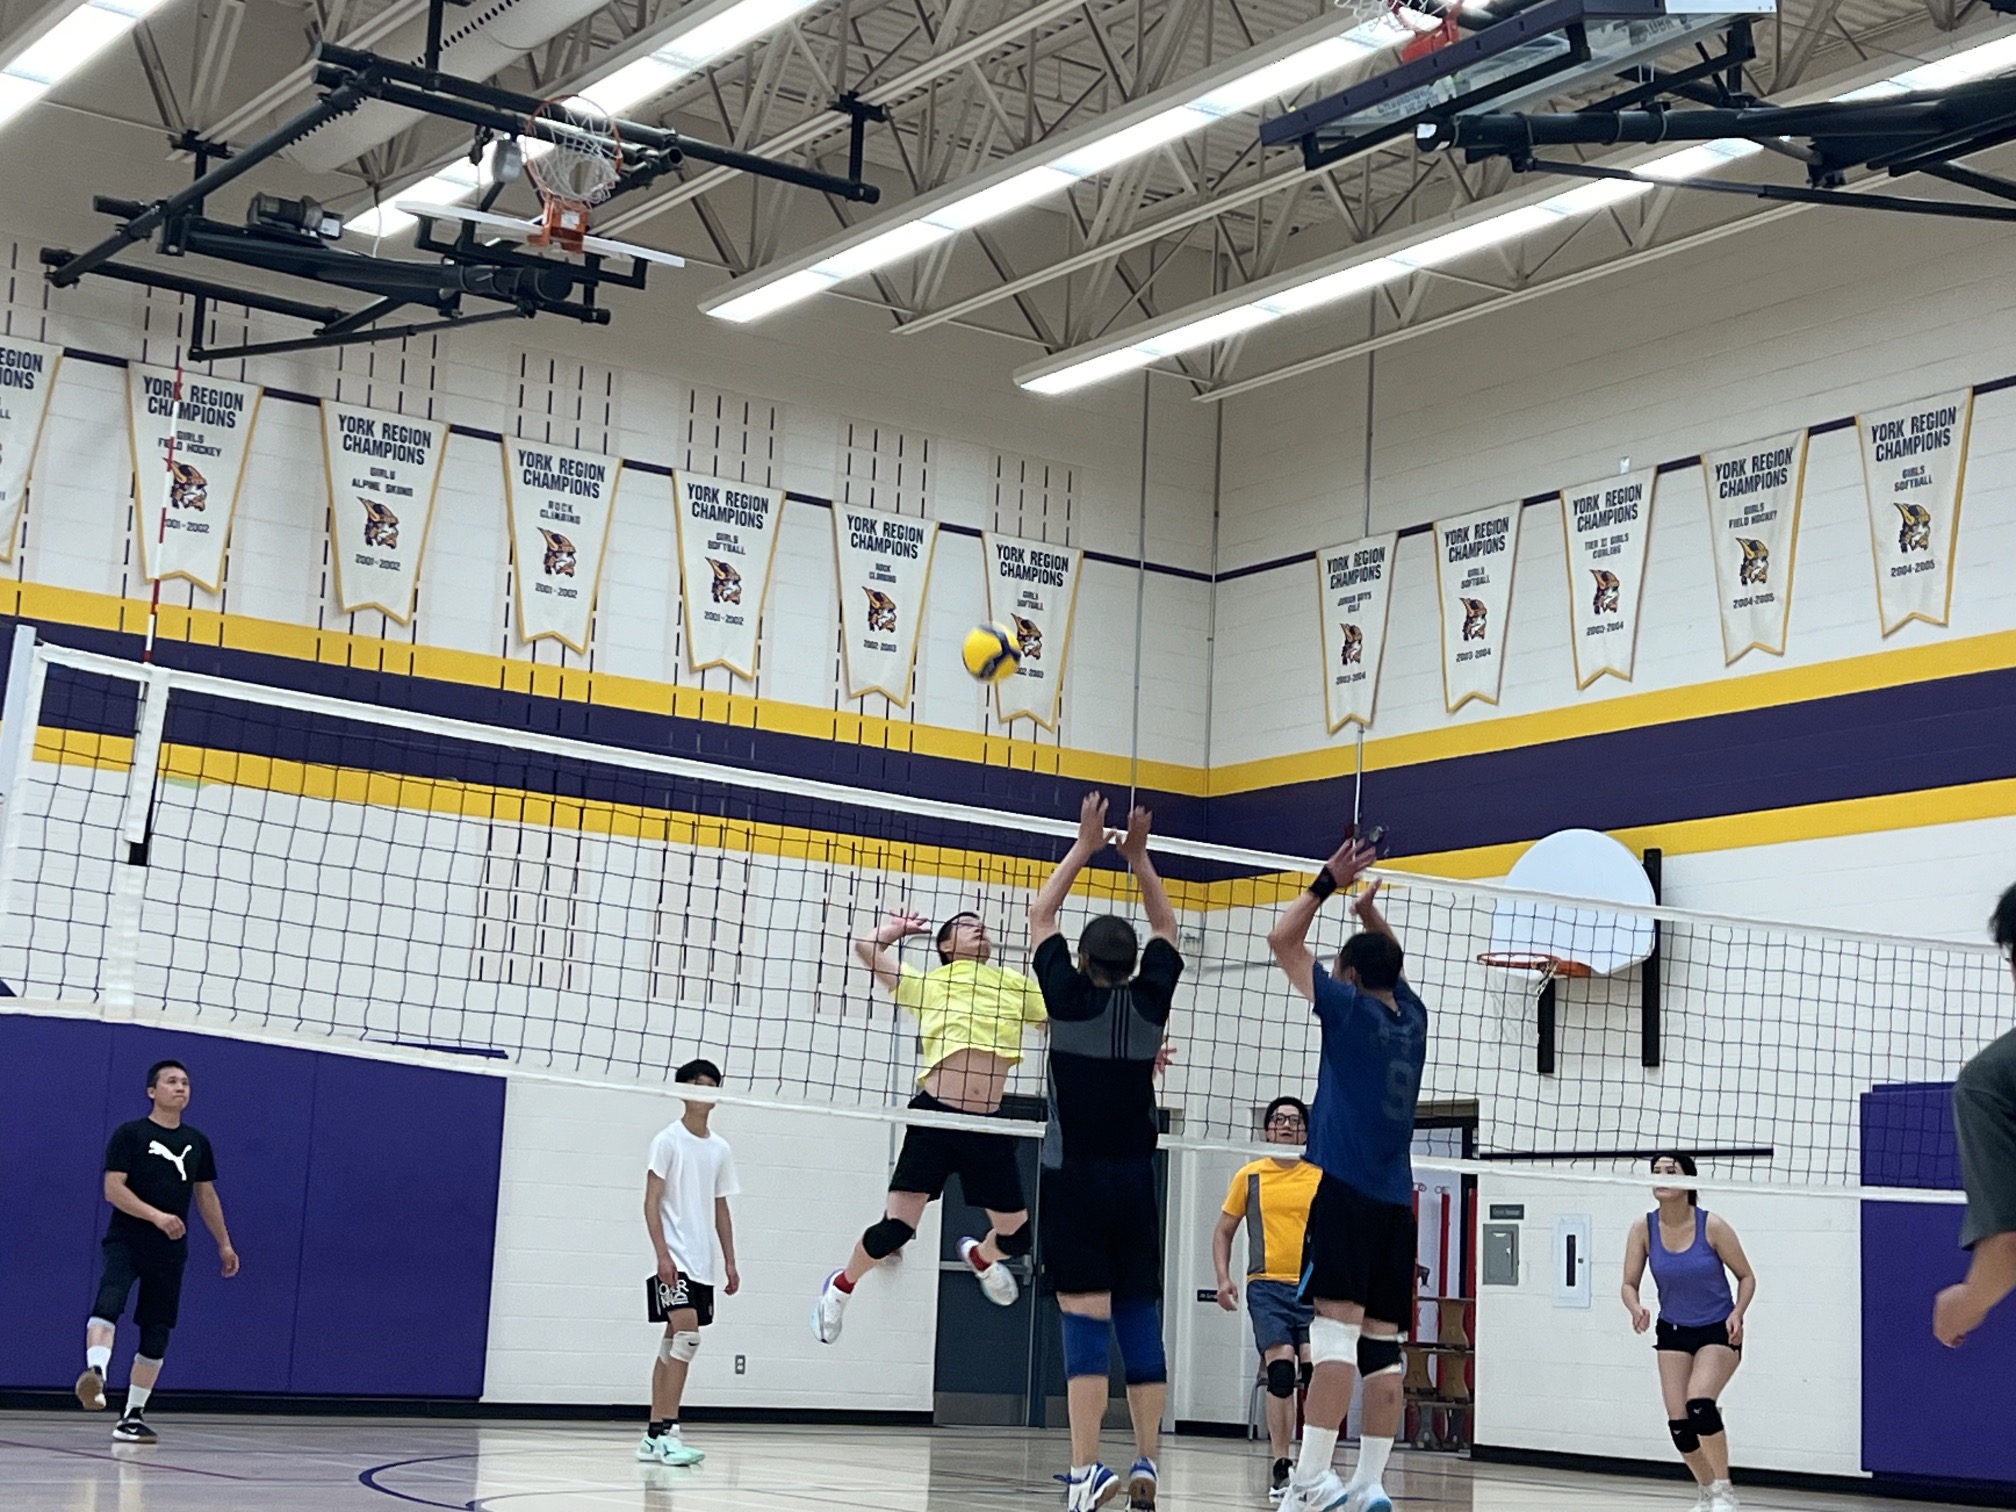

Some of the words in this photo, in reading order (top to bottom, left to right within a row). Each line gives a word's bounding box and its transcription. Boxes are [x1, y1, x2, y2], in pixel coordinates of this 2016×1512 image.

[190, 385, 244, 412] REGION
[177, 431, 204, 444] GIRLS
[338, 414, 376, 438] YORK
[382, 423, 432, 449] REGION
[1871, 419, 1905, 444] YORK
[1911, 406, 1957, 435] REGION
[343, 434, 425, 465] CHAMPIONS
[1876, 428, 1951, 462] CHAMPIONS
[518, 449, 553, 472] YORK
[559, 457, 606, 483] REGION
[1715, 458, 1747, 482] YORK
[1752, 446, 1794, 474] REGION
[1902, 465, 1925, 479] GIRLS
[523, 469, 600, 499] CHAMPIONS
[687, 482, 720, 504] YORK
[726, 490, 769, 514] REGION
[1720, 467, 1788, 499] CHAMPIONS
[1893, 475, 1933, 492] SOFTBALL
[548, 500, 573, 513] ROCK
[1573, 493, 1600, 516] YORK
[1605, 482, 1643, 508] REGION
[692, 502, 764, 530] CHAMPIONS
[847, 514, 878, 536] YORK
[883, 521, 924, 545] REGION
[1577, 503, 1638, 533] CHAMPIONS
[1729, 516, 1750, 529] FIELD
[851, 532, 918, 560] CHAMPIONS
[1444, 525, 1470, 548] YORK
[1474, 516, 1510, 540] REGION
[996, 543, 1025, 564] YORK
[1030, 550, 1069, 573] REGION
[1327, 554, 1350, 574] YORK
[1353, 546, 1386, 567] REGION
[1449, 535, 1506, 563] CHAMPIONS
[1000, 561, 1064, 588] CHAMPIONS
[1330, 564, 1382, 590] CHAMPIONS
